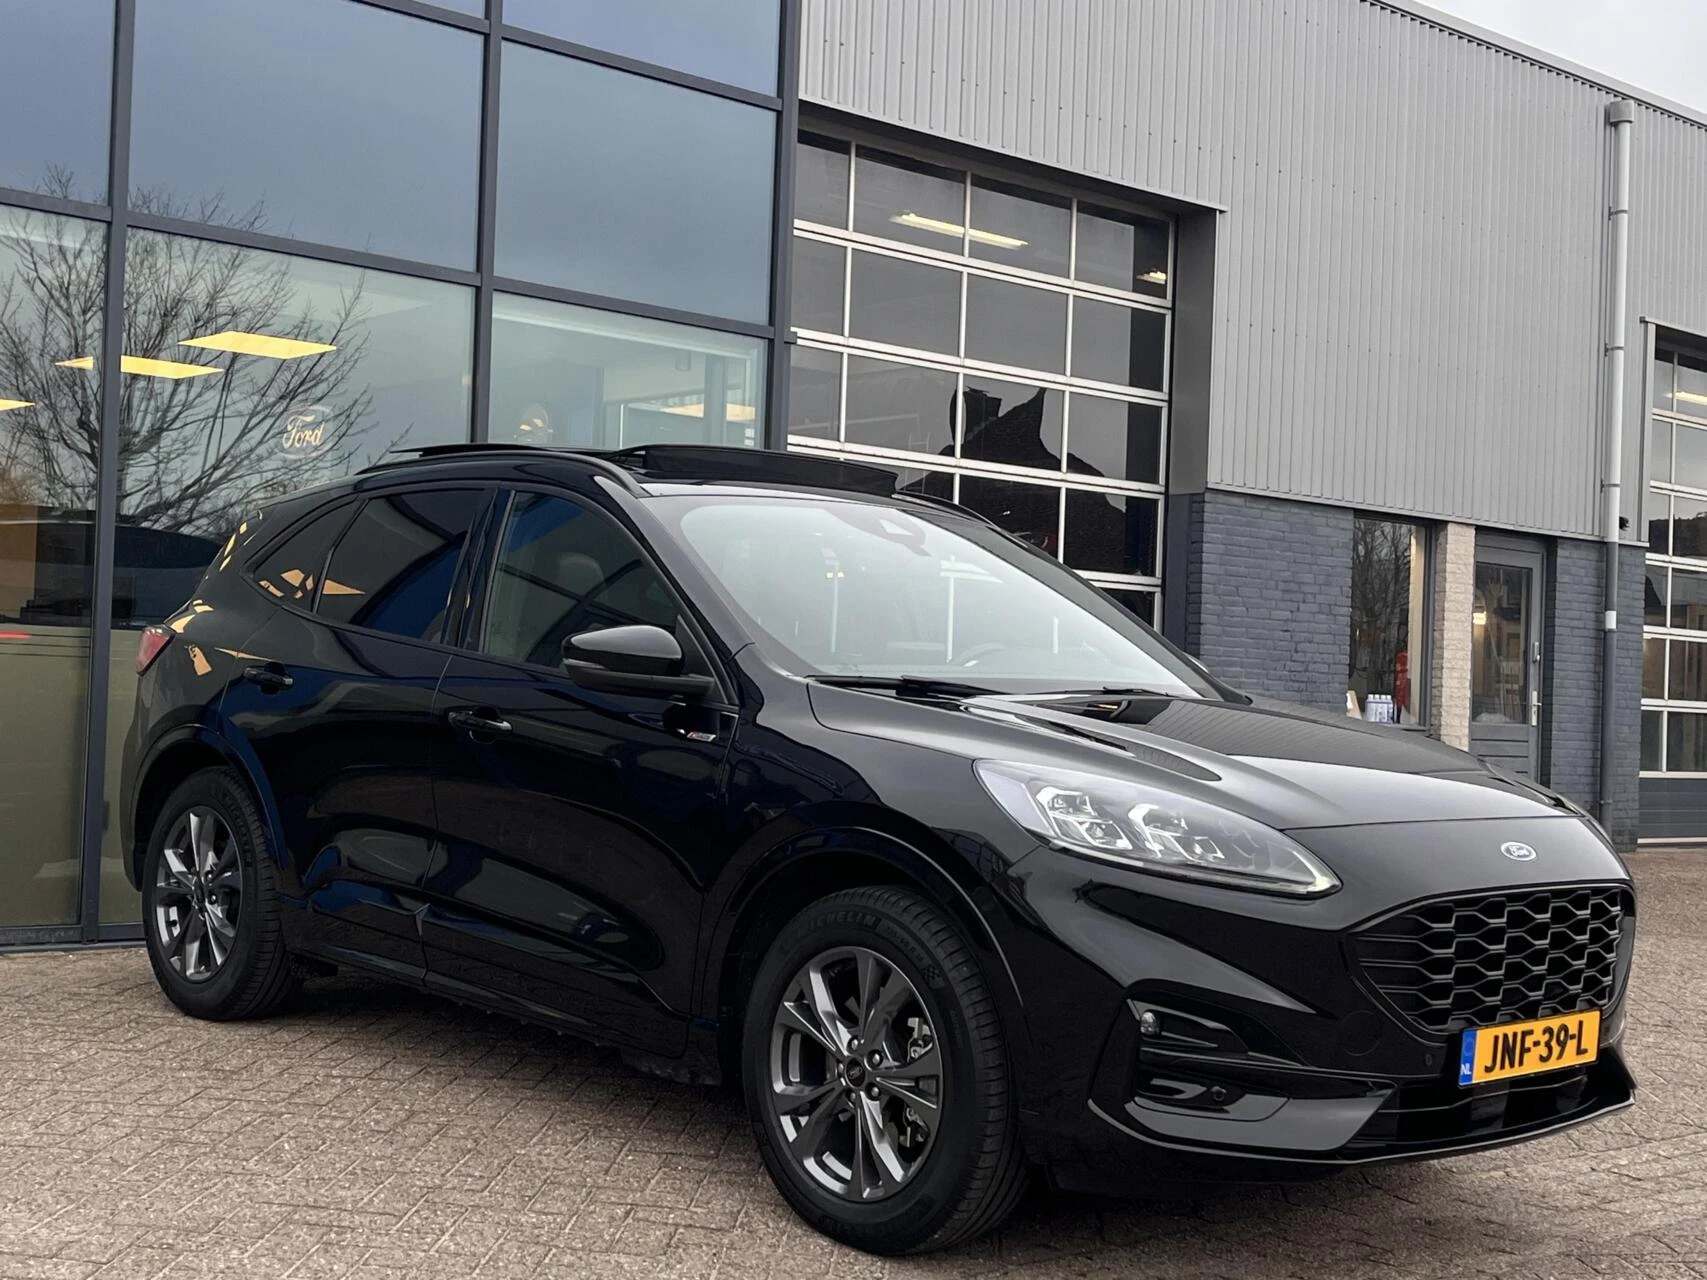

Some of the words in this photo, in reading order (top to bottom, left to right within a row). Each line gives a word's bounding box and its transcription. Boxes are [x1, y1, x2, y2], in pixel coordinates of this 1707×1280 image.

[282, 414, 325, 449] Ford
[1484, 1020, 1588, 1073] JNF-39-L
[1460, 1063, 1472, 1075] NL
